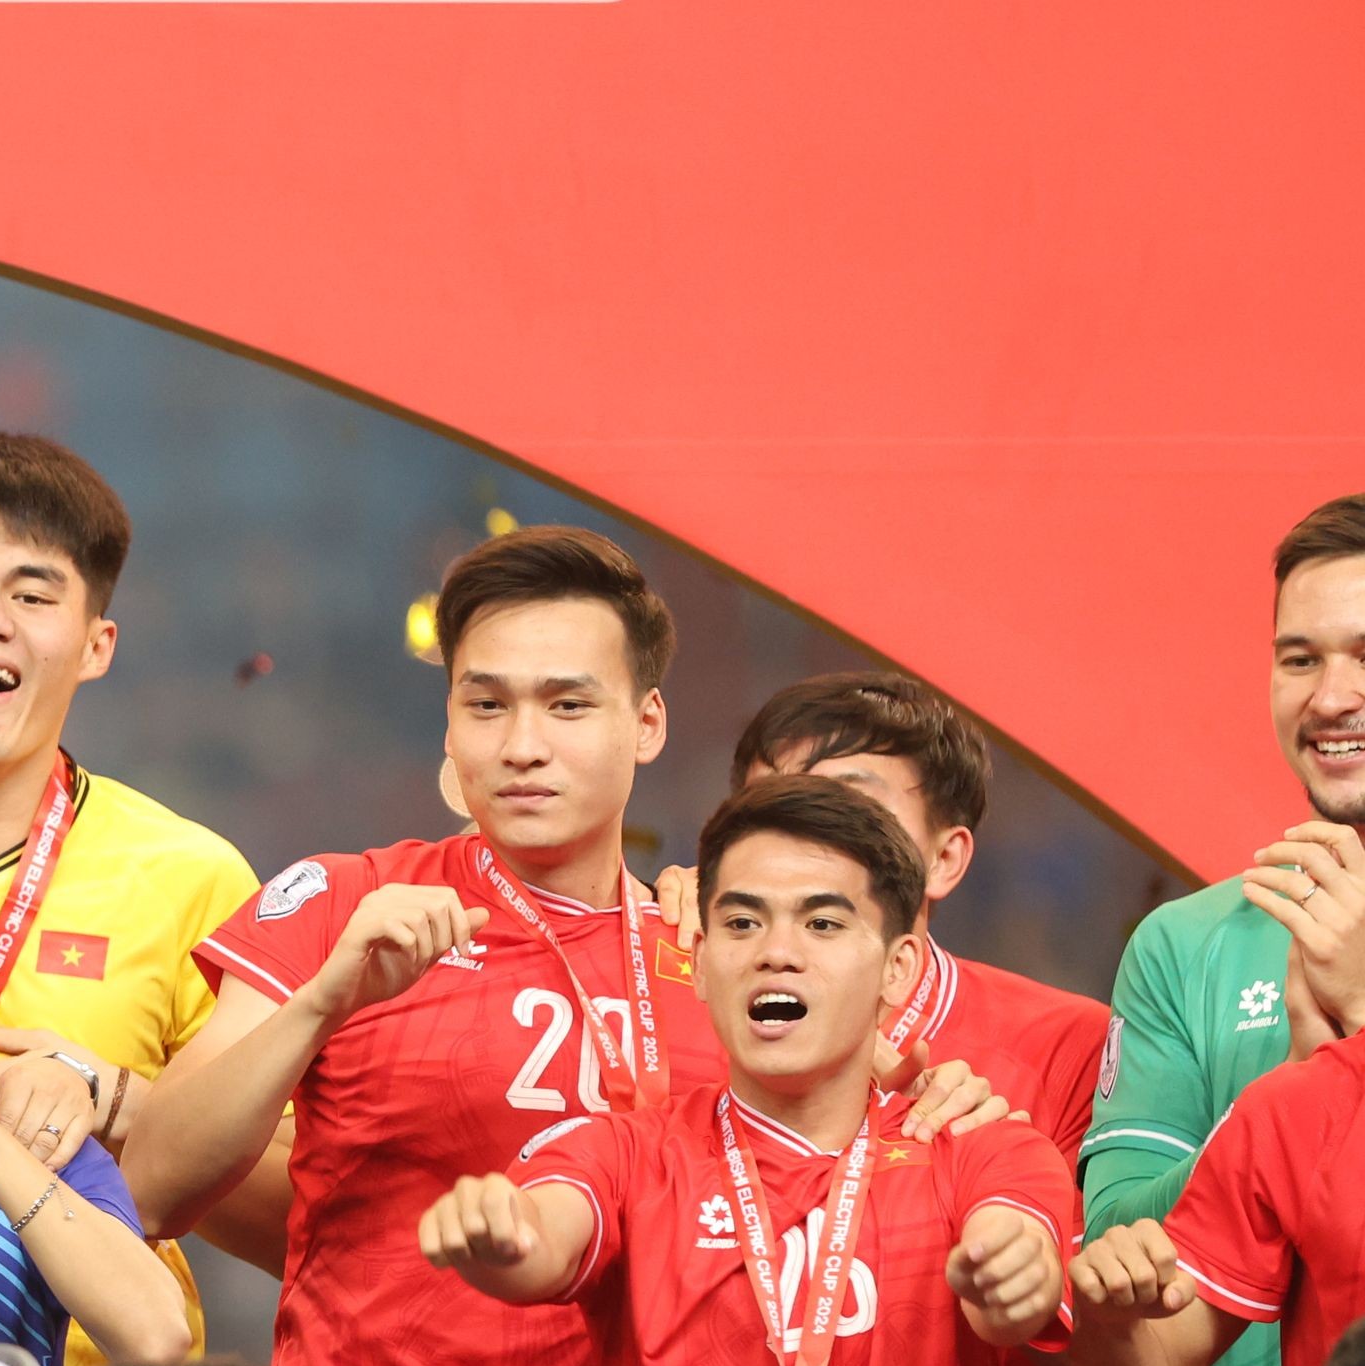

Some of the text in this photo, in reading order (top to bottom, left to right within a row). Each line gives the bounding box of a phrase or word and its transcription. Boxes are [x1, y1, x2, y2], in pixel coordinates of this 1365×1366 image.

[32, 790, 69, 867] MITSUBISHI
[5, 864, 44, 934] ELECTRIC
[487, 866, 547, 932] MITSUBISHI
[597, 1032, 620, 1069] 2024
[630, 931, 650, 998] ELECTRIC
[639, 1000, 655, 1032] CUP
[890, 1006, 921, 1050] ELEC
[1234, 1015, 1279, 1032] JOGARBOLA
[505, 987, 636, 1113] 20
[643, 1036, 659, 1073] 2024
[719, 1110, 782, 1338] MITSUBISHI ELECTRIC CUP 2024
[829, 1178, 859, 1252] ELECTRIC
[822, 1255, 842, 1291] CUP
[812, 1297, 833, 1336] 2024
